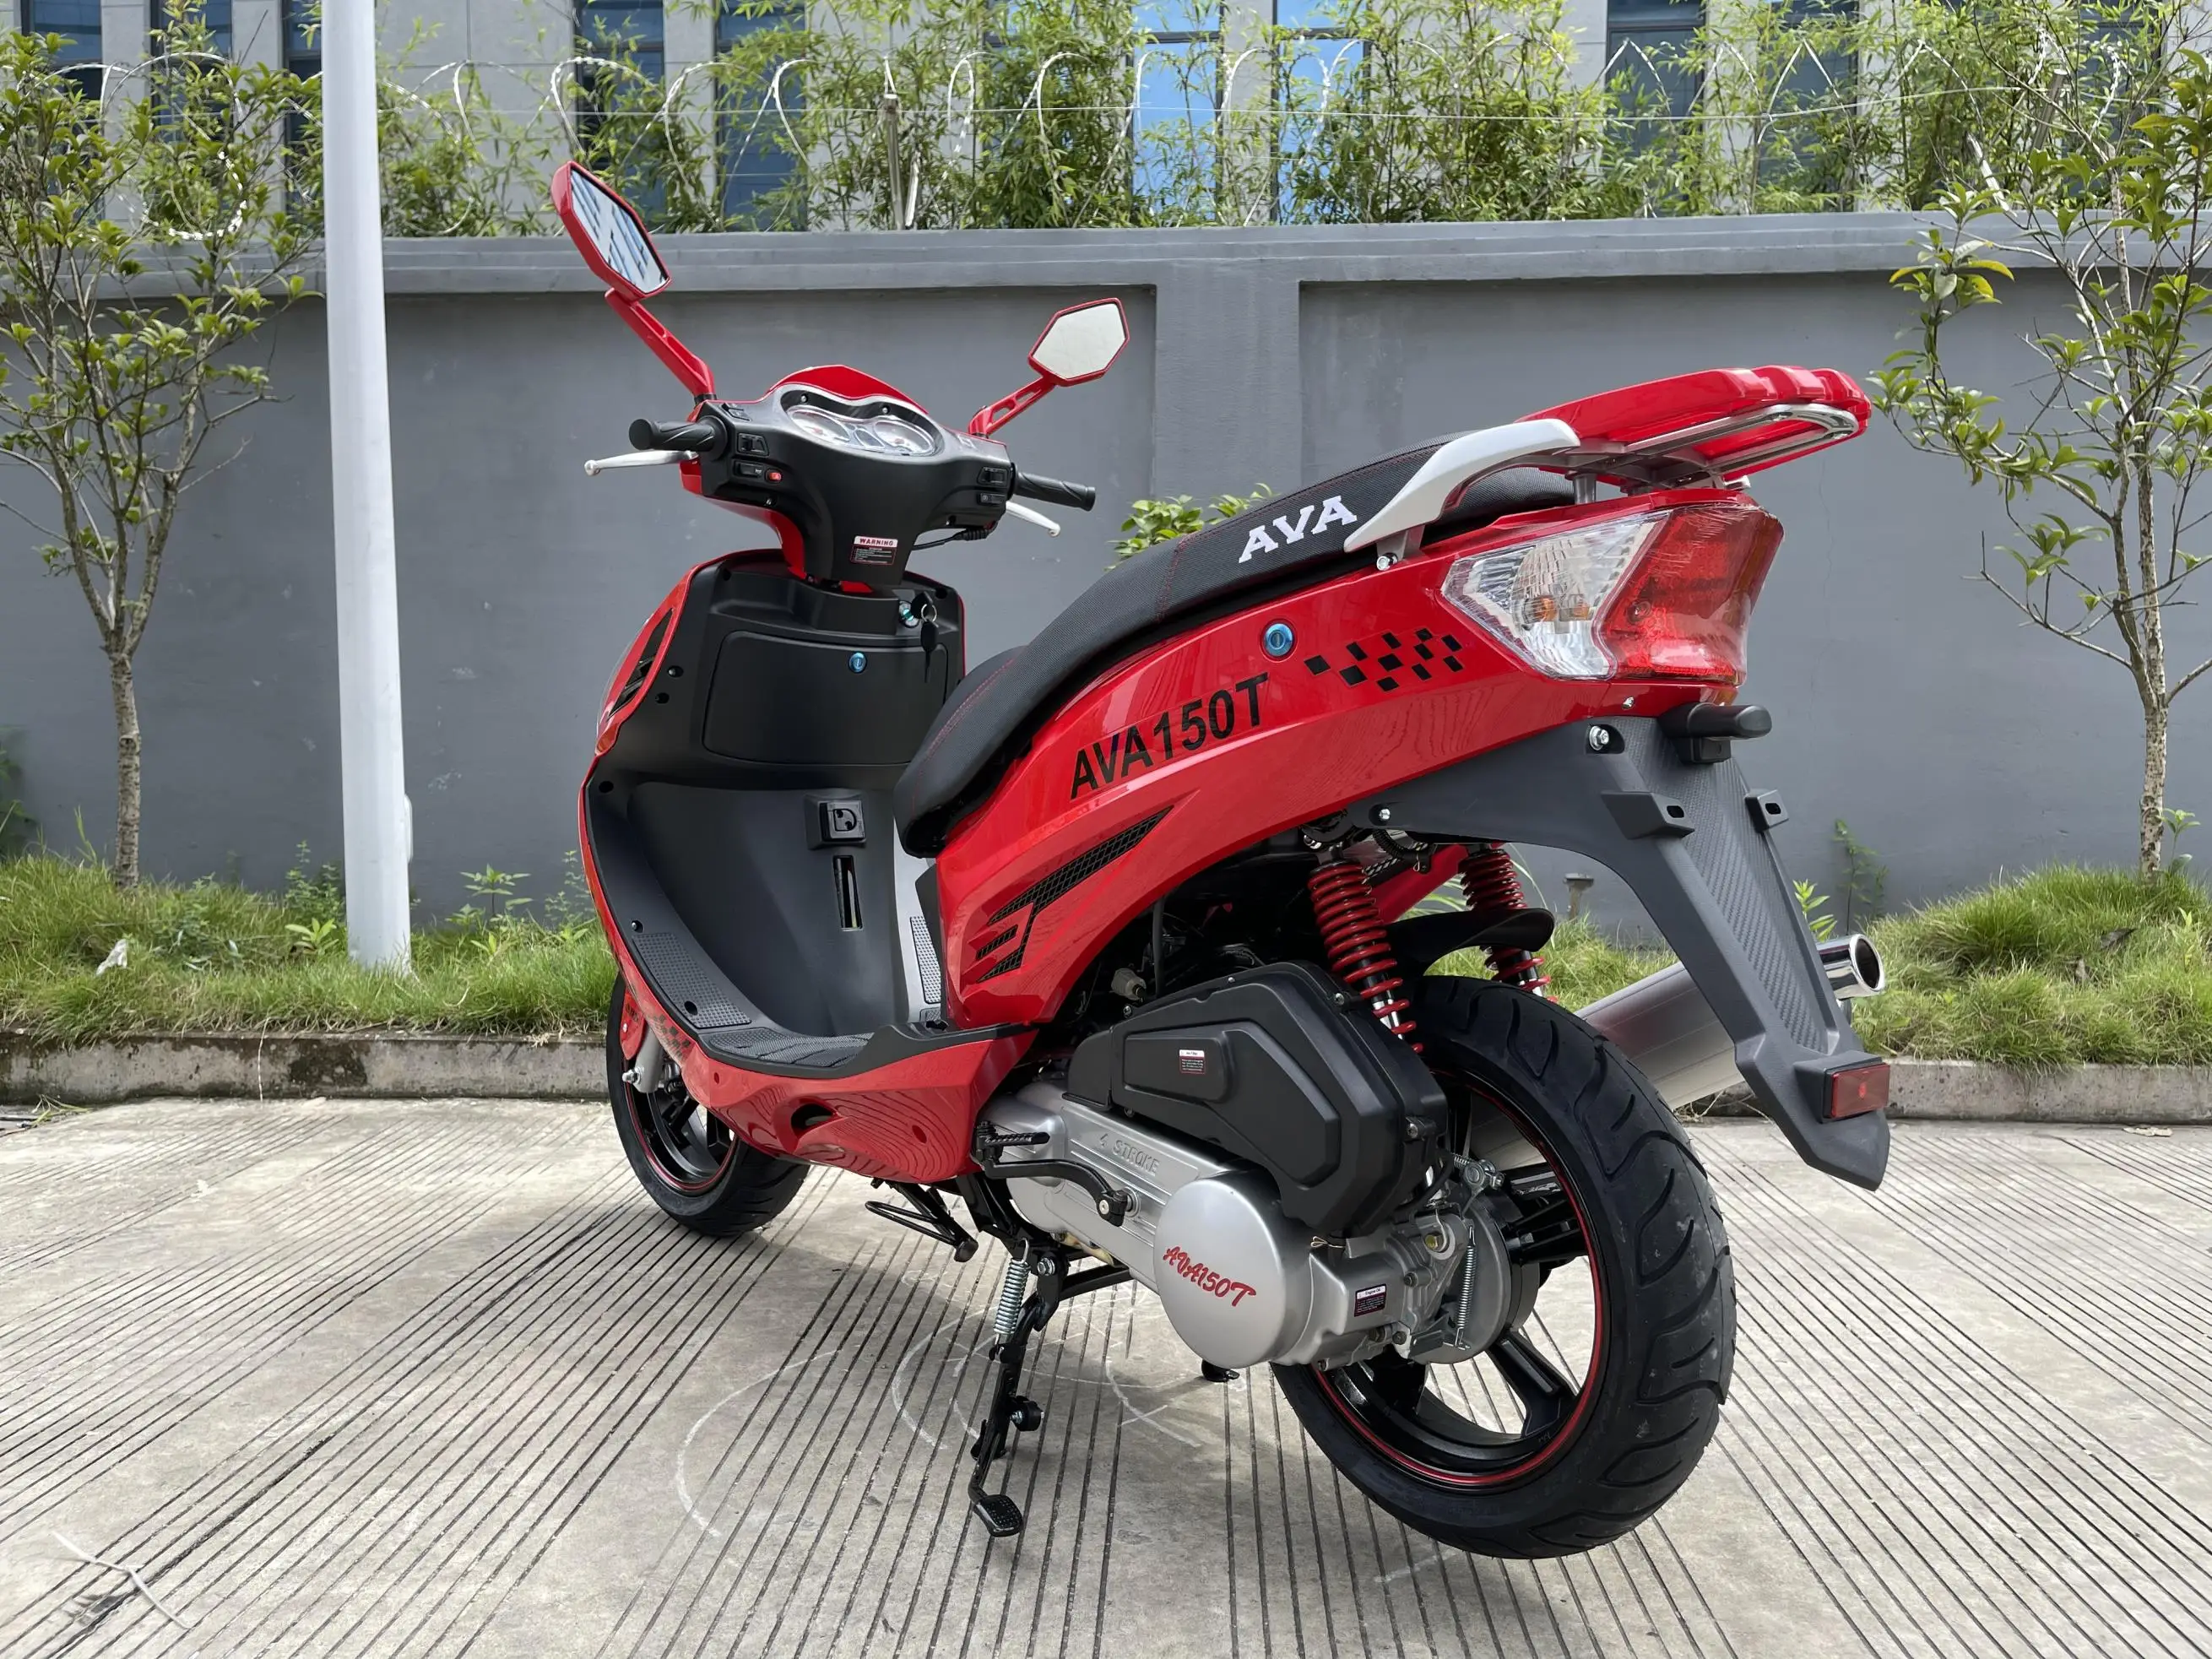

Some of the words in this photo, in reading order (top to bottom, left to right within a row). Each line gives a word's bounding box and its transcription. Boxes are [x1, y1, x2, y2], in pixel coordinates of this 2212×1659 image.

[859, 538, 893, 546] WARNING
[1239, 495, 1358, 564] AVA
[1071, 673, 1271, 800] AVA150T
[1100, 1133, 1109, 1147] 4
[1113, 1139, 1160, 1176] STROKE
[1163, 1246, 1256, 1307] AVA150T
